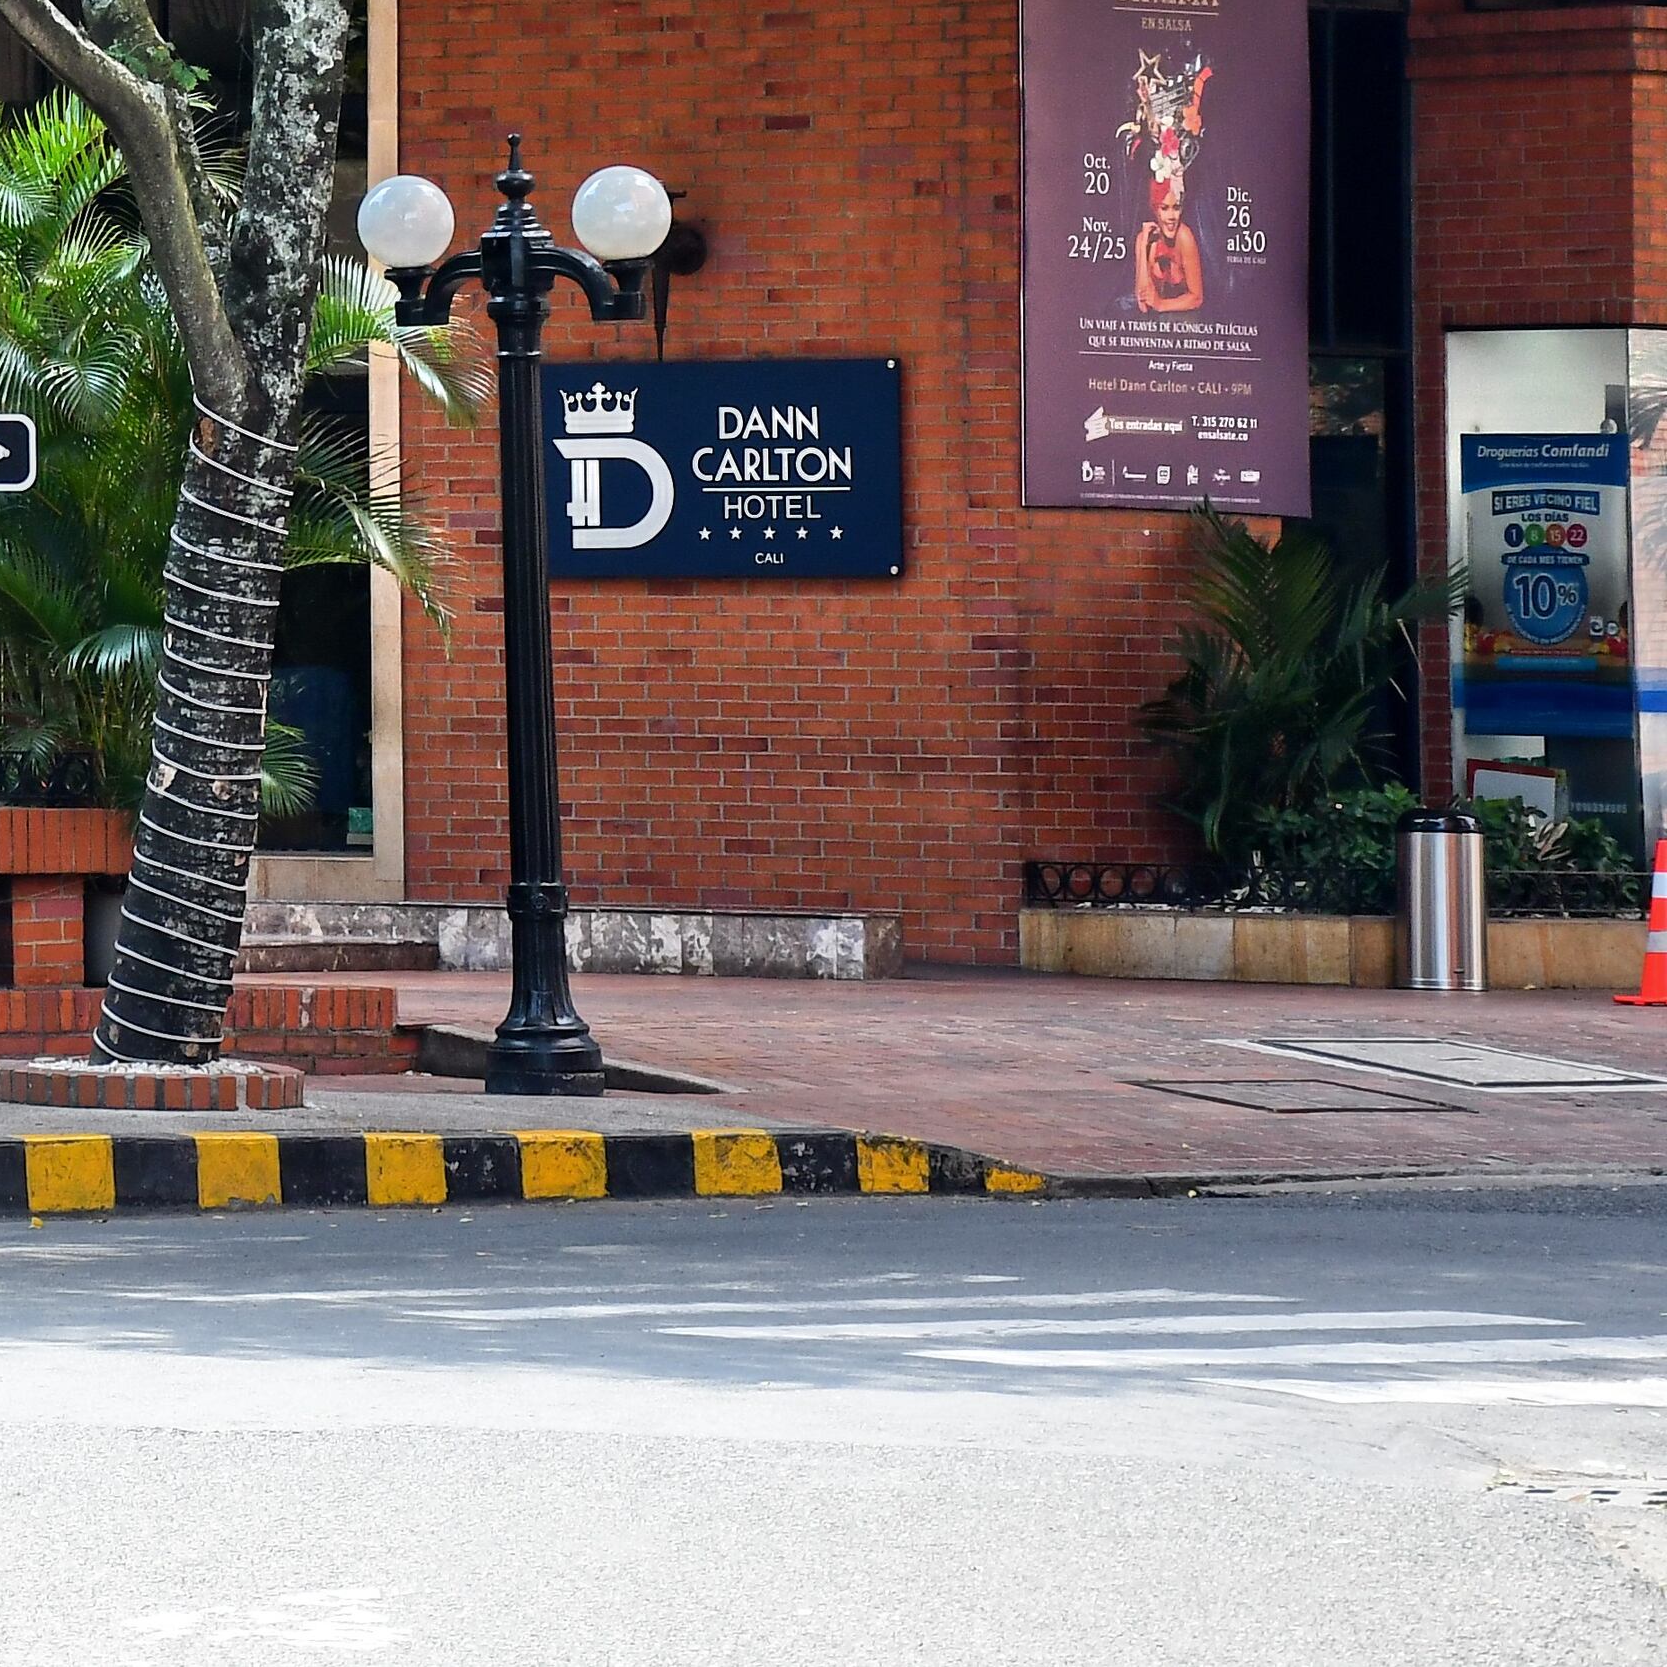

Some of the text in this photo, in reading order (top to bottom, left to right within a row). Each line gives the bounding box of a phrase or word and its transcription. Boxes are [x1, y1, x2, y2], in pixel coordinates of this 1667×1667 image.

[1141, 17, 1192, 31] EN SALSA
[1084, 153, 1111, 169] Oct.
[1084, 171, 1110, 195] 20
[1227, 186, 1252, 203] Dic.
[1227, 205, 1251, 228] 26
[1083, 217, 1112, 233] Nov.
[1067, 234, 1127, 263] 24/25
[1096, 319, 1117, 332] VIAJE
[1120, 321, 1126, 331] A
[1128, 320, 1157, 333] TRAVÉS
[1160, 322, 1171, 333] DE
[1173, 321, 1213, 335] ICÓNICAS
[1088, 335, 1106, 348] QUE
[1108, 336, 1117, 346] SE
[1121, 336, 1173, 349] REINVENTAN
[1175, 339, 1183, 349] A
[1183, 338, 1212, 351] RITMO
[1213, 340, 1225, 351] DE
[1148, 360, 1193, 373] Arte y Fiesta
[1088, 378, 1252, 396] Hotel Dann Carlton CALI 9PM
[718, 405, 819, 440] DANN
[1126, 418, 1163, 431] entradas
[1164, 420, 1183, 434] aquí
[1191, 416, 1200, 426] T.
[1202, 416, 1217, 427] 315
[1219, 416, 1235, 428] 270
[1250, 418, 1258, 429] 11
[1541, 443, 1610, 458] Comfandi
[691, 446, 852, 482] CARLTON
[724, 494, 821, 520] HOTEL
[1494, 493, 1597, 512] SI ERES VECINO FIEL
[1521, 512, 1542, 523] LOS
[1510, 530, 1516, 541] 1
[1550, 530, 1562, 542] 15
[1570, 530, 1584, 542] 22
[755, 552, 784, 565] CALI
[1513, 573, 1579, 620] 10%
